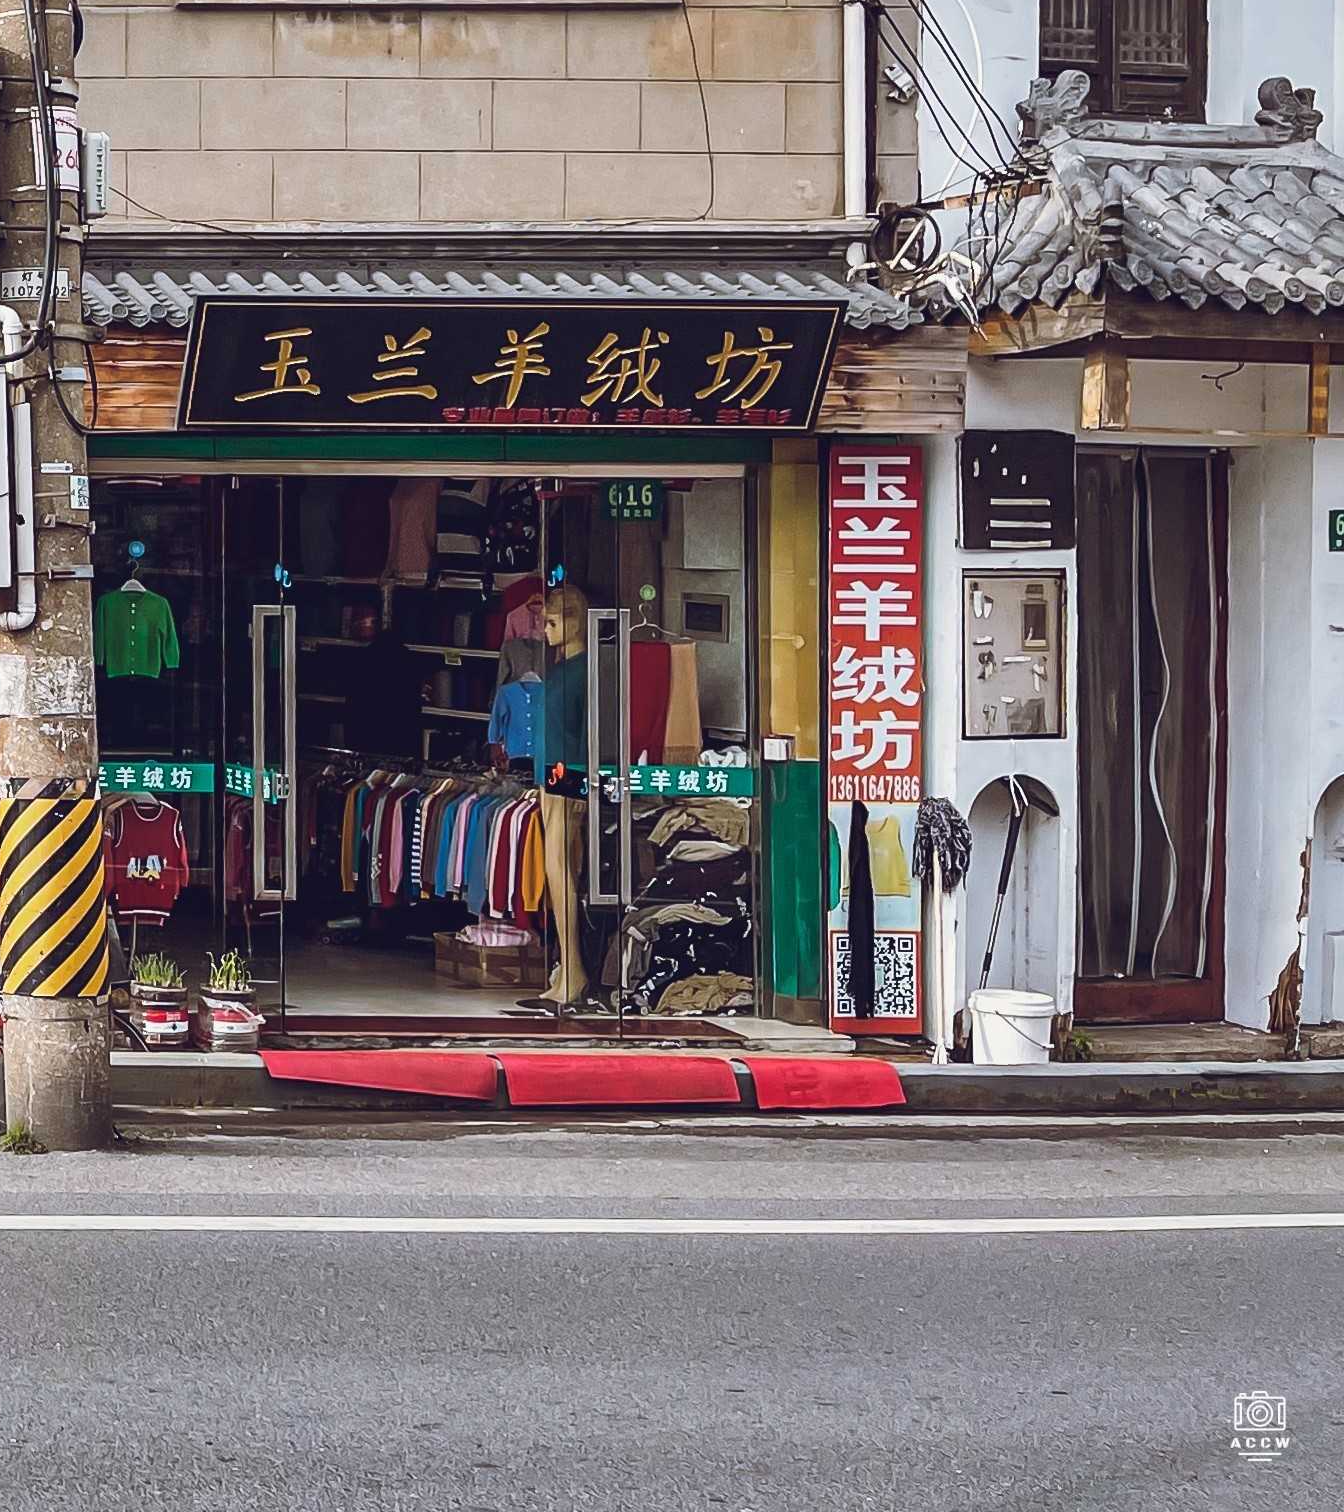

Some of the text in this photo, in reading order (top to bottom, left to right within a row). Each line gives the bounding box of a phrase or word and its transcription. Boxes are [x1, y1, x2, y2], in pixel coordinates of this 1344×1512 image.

[234, 320, 794, 410] 玉兰羊绒坊
[608, 483, 653, 506] 616
[831, 453, 920, 772] 玉兰羊绒坊
[830, 775, 921, 801] 13611647886
